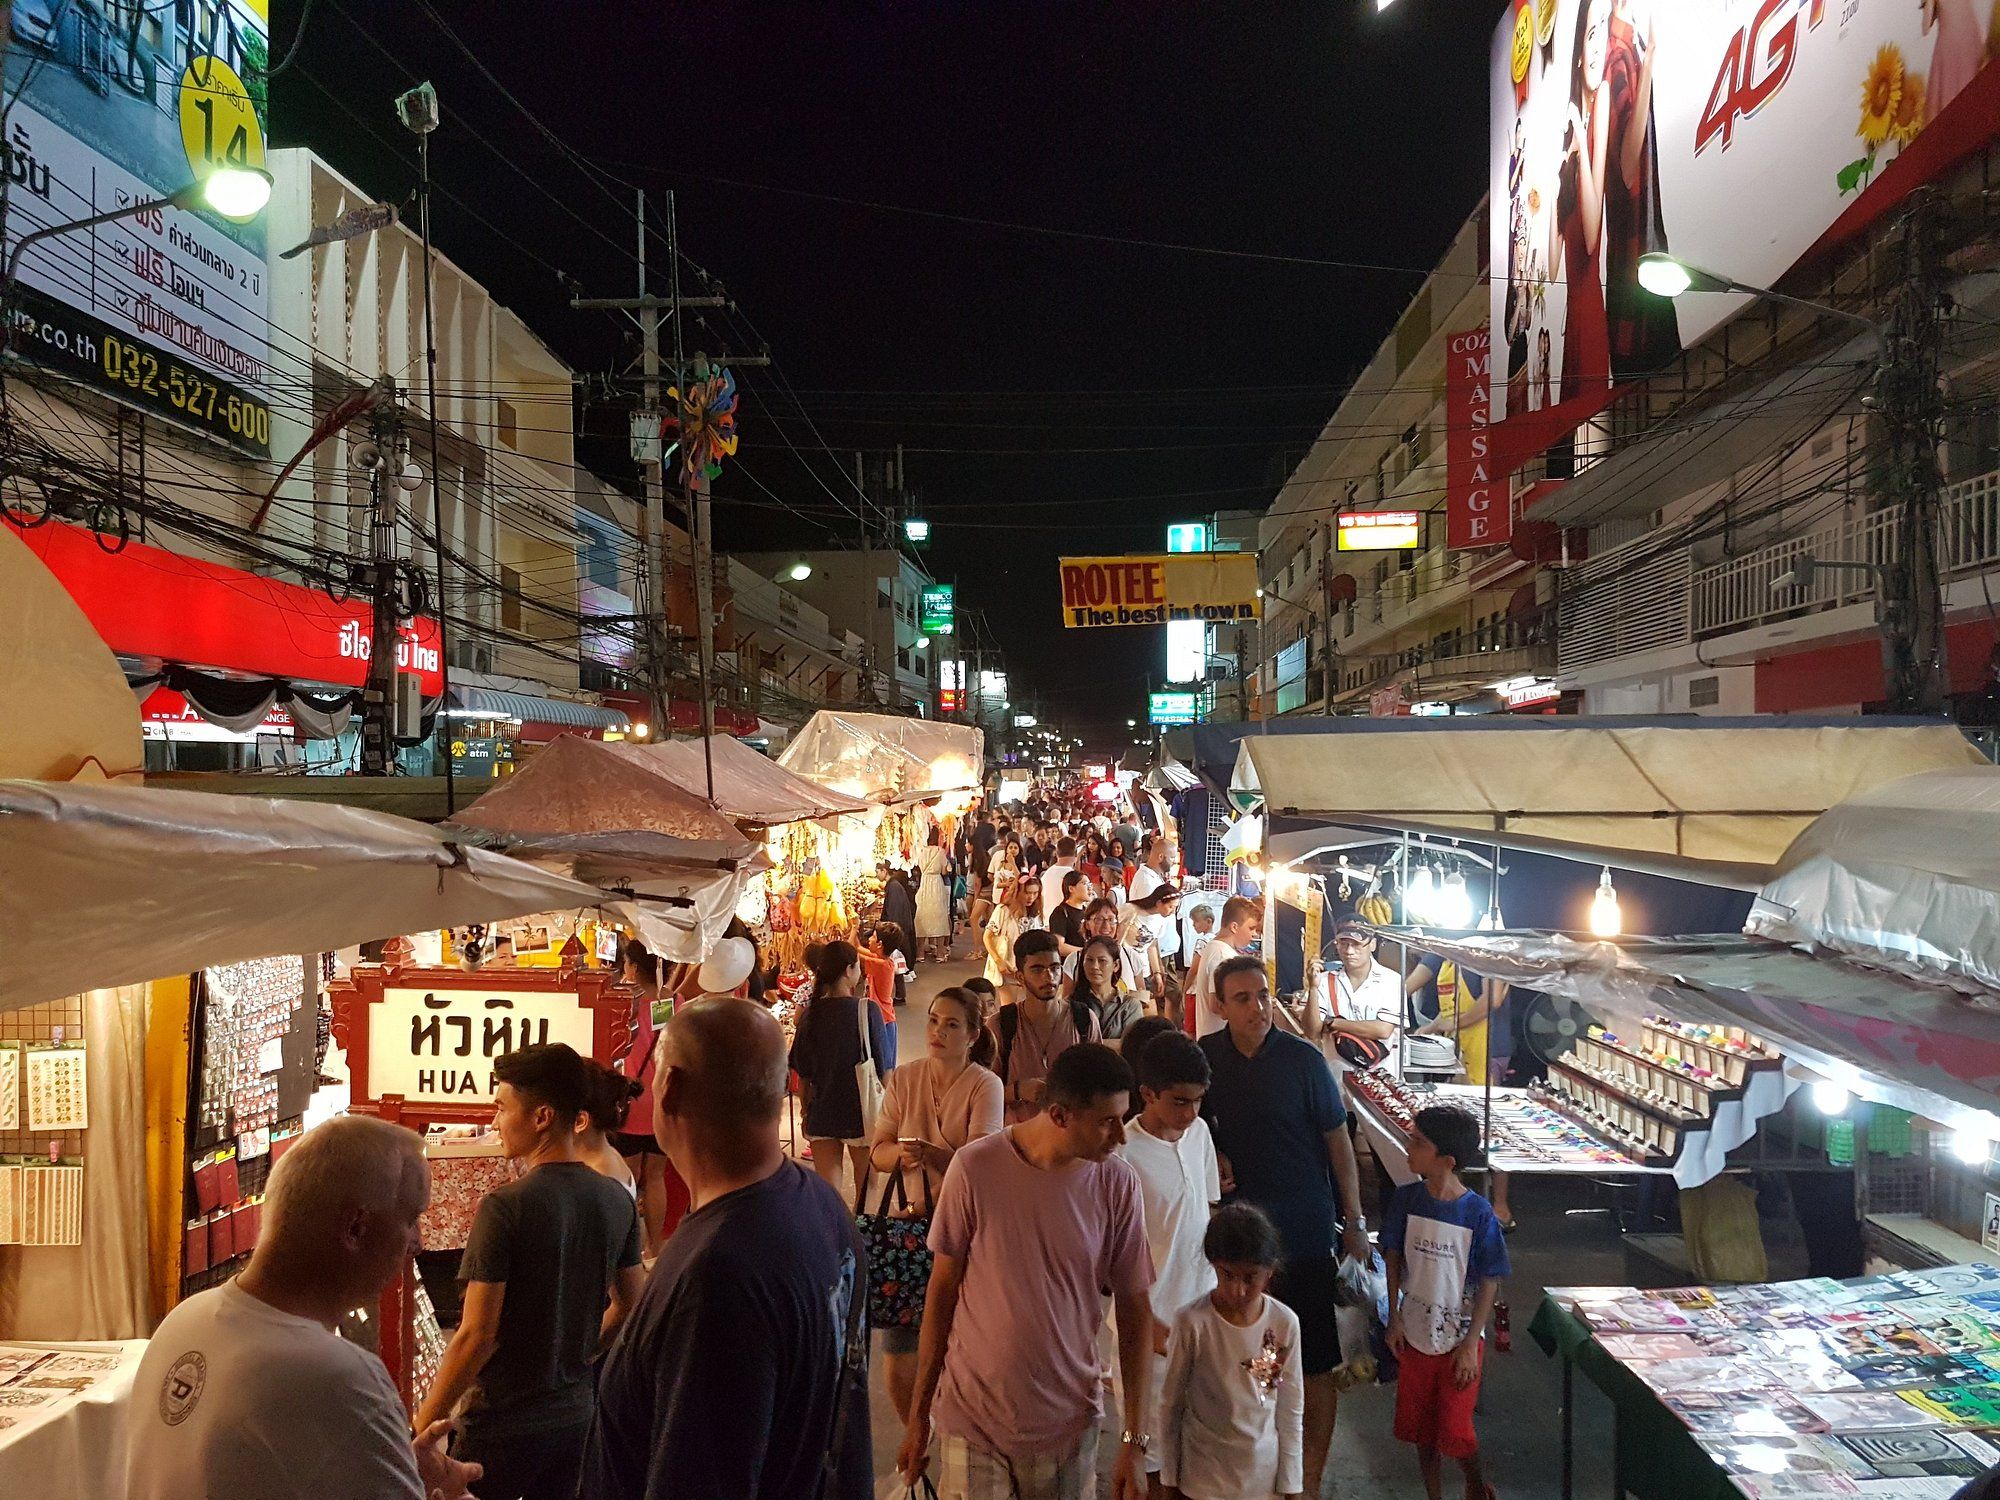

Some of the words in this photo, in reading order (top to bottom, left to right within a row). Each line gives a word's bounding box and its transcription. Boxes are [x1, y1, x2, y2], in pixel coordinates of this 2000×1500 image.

[195, 97, 247, 168] 1.4
[135, 194, 164, 236] ฟร
[240, 269, 248, 290] 2
[253, 273, 260, 297] ปี
[135, 247, 164, 288] ฟรี
[8, 308, 97, 363] m.co.th
[103, 335, 268, 445] 032-527-600
[1464, 354, 1491, 540] MASSAGE
[923, 591, 953, 600] TESCO
[1062, 563, 1164, 607] ROTEE
[1071, 607, 1114, 627] The
[1117, 604, 1167, 624] best
[1168, 604, 1189, 620] in
[1193, 603, 1254, 621] town
[411, 633, 438, 672] ไทย
[264, 713, 290, 723] ANGE
[470, 750, 489, 758] atm
[410, 993, 549, 1058] หัวหิน
[418, 1069, 479, 1095] HUA
